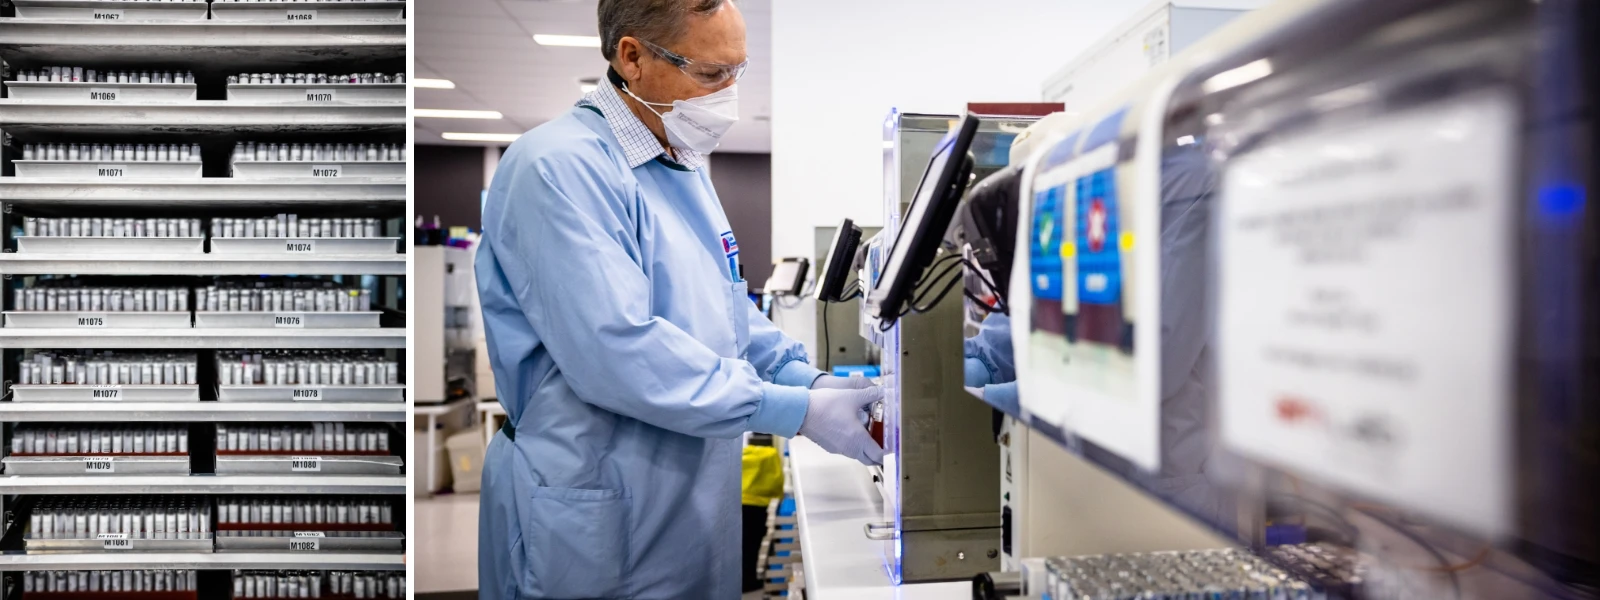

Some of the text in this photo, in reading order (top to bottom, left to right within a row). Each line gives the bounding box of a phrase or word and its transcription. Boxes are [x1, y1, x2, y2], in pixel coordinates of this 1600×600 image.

[90, 92, 116, 100] M1069
[307, 93, 332, 101] M1070
[98, 169, 123, 177] M1071
[312, 169, 337, 177] M1072
[286, 243, 311, 251] M1074
[78, 317, 103, 326] M1075
[275, 317, 300, 325] M1076
[93, 390, 118, 398] M1077
[293, 389, 318, 397] M1078
[86, 462, 111, 470] M1079
[290, 542, 315, 550] M1082
